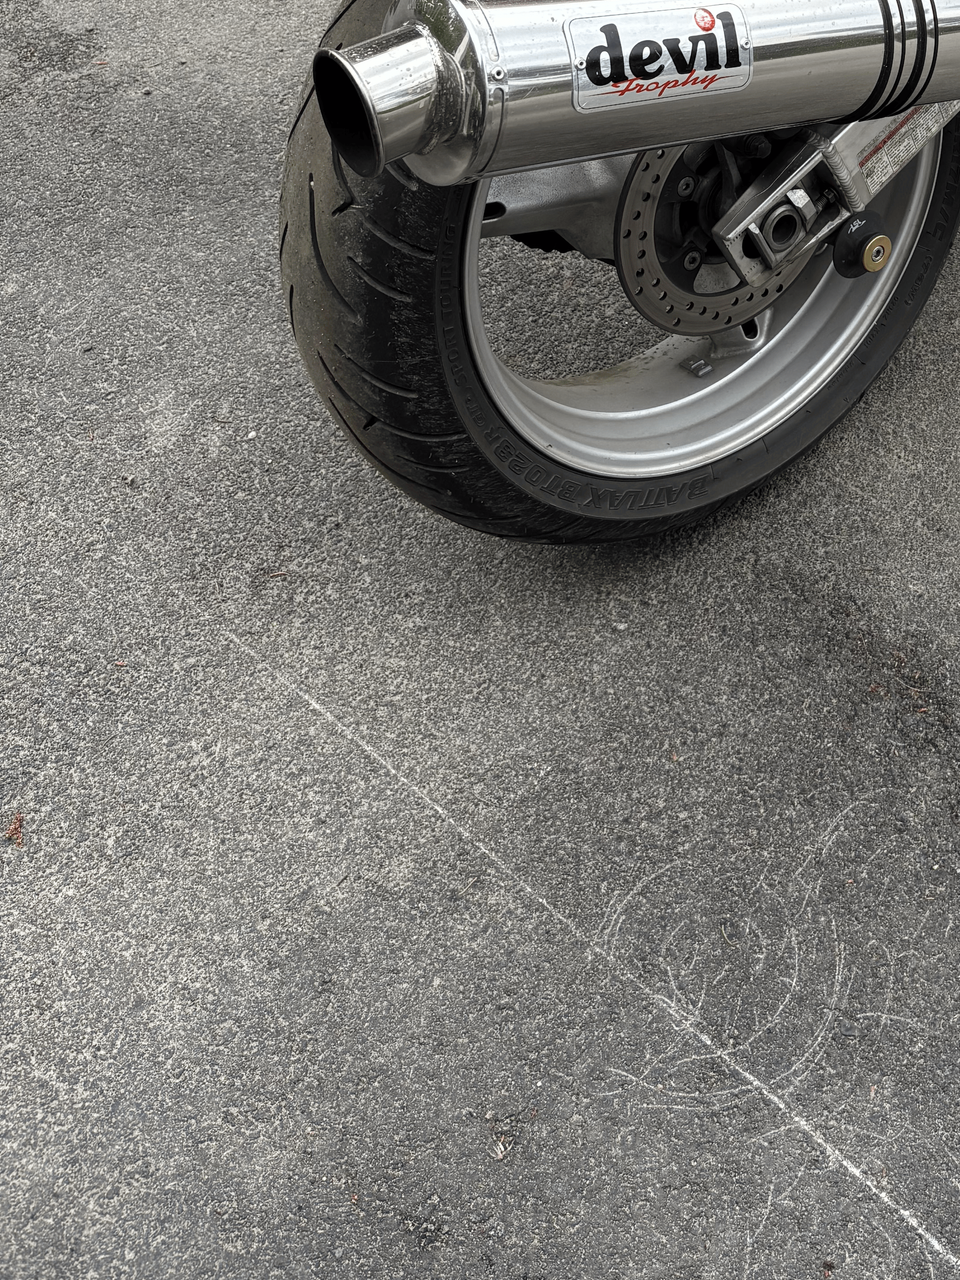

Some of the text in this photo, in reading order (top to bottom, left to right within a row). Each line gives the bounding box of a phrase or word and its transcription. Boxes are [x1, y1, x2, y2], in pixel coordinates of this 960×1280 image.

[586, 8, 742, 85] devil
[598, 68, 732, 97] Trophy
[440, 224, 455, 321] TOURING
[443, 326, 468, 387] SPORT
[584, 473, 709, 511] BATTLAX
